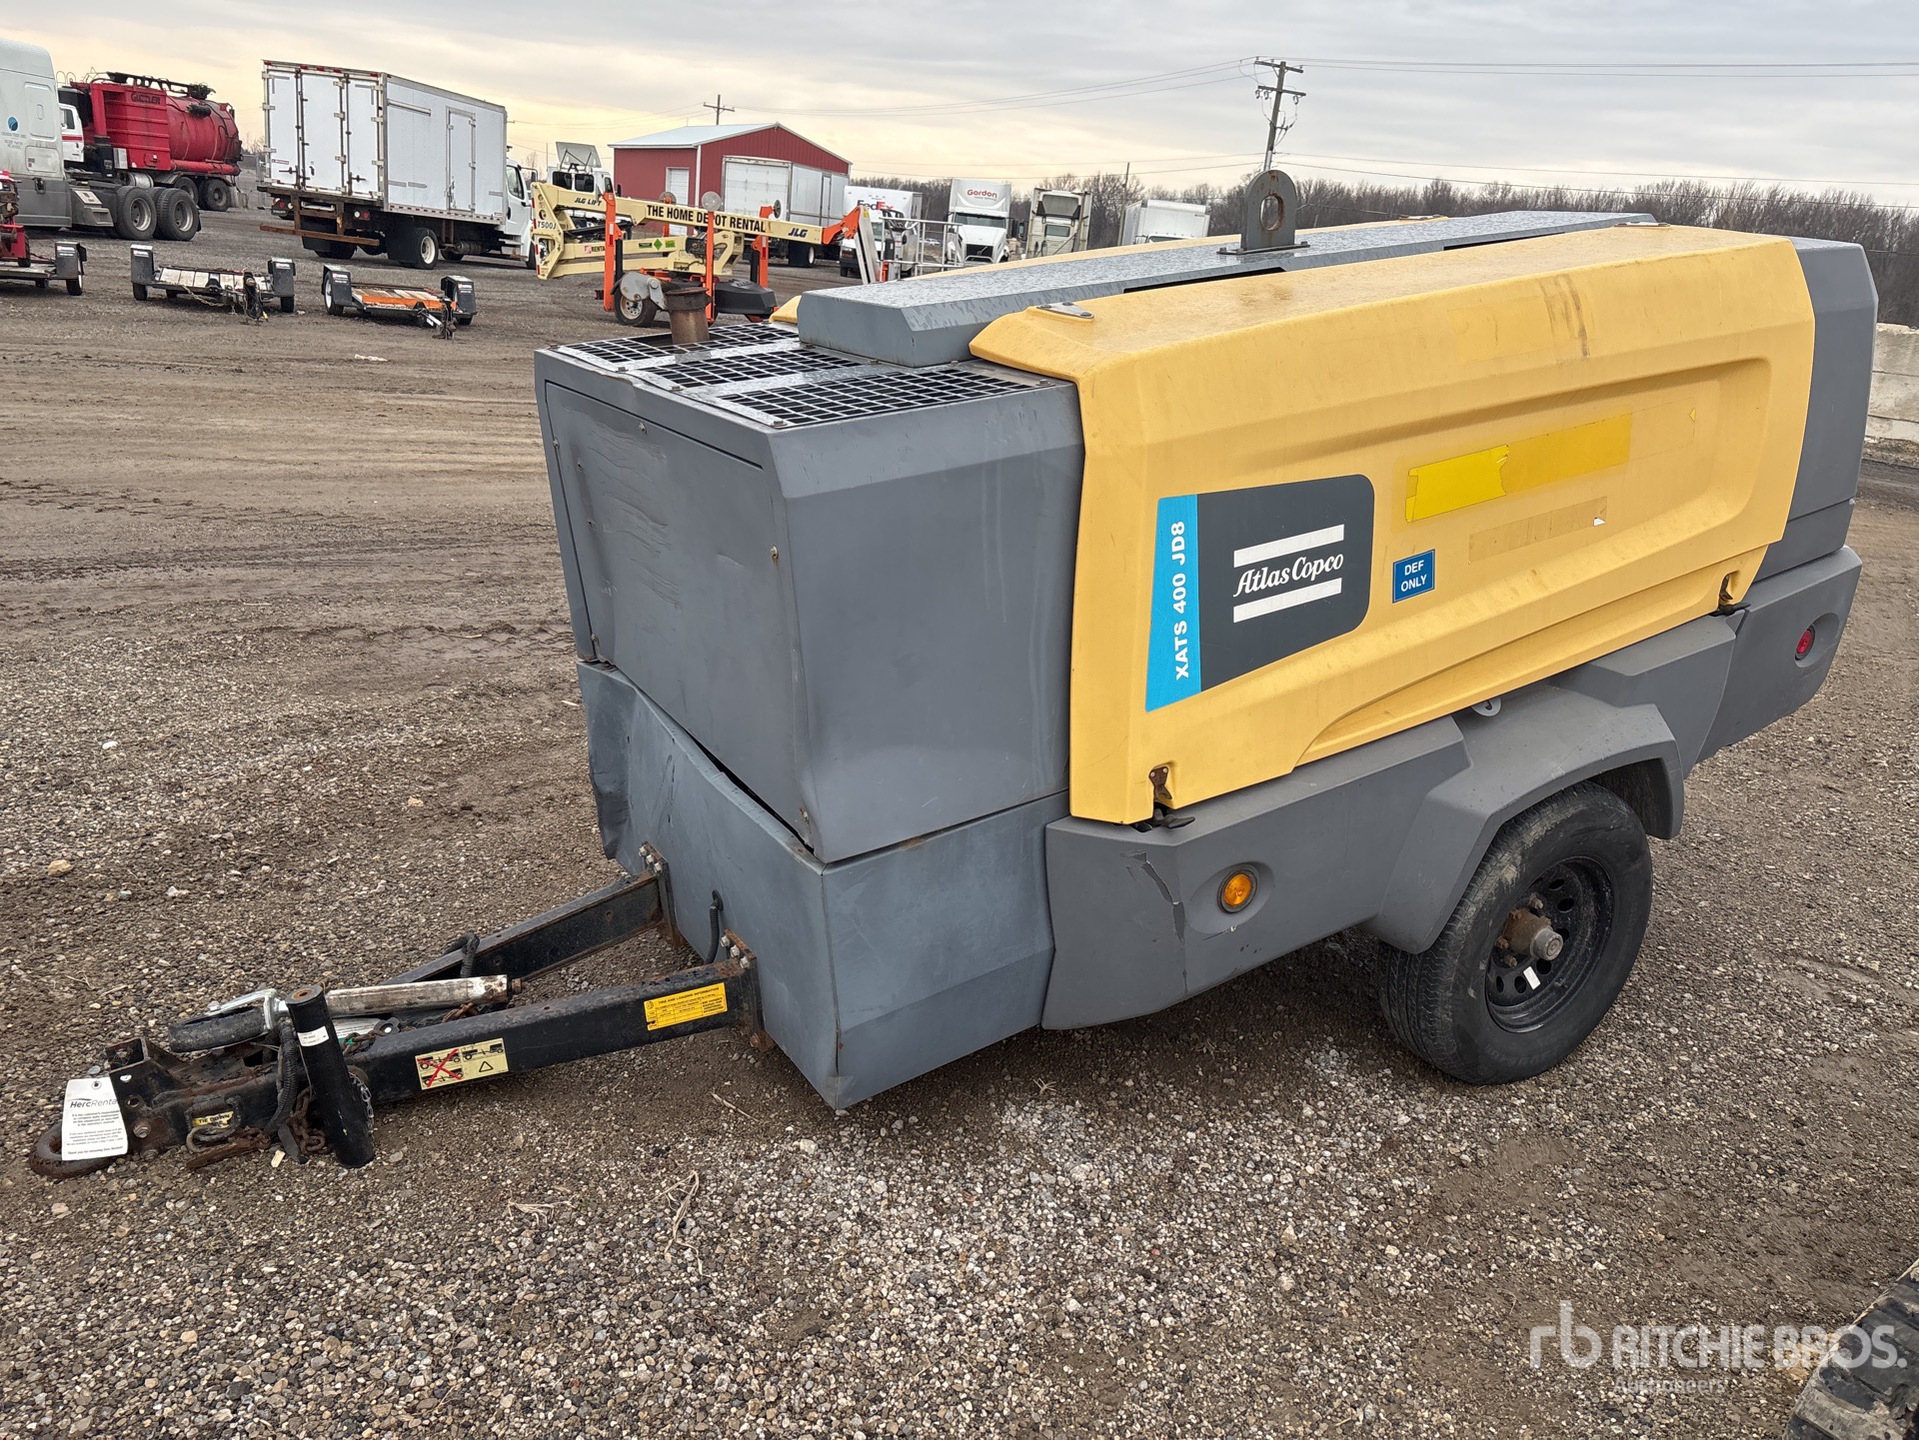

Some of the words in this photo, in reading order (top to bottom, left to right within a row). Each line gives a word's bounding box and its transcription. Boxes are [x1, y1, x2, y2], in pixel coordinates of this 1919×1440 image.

[575, 197, 586, 205] JLG
[966, 188, 998, 198] Gordon
[538, 220, 557, 230] T500J
[647, 204, 664, 217] THE
[667, 207, 694, 222] HOME
[696, 211, 728, 227] DEOT
[729, 216, 766, 233] RENTAL
[788, 227, 808, 238] JLG
[591, 245, 606, 253] RENTA
[1170, 520, 1186, 566] JD8
[1232, 566, 1290, 598] Atlas
[1291, 553, 1345, 582] Copco
[1403, 559, 1425, 577] DEF
[1400, 574, 1428, 593] ONLY
[1172, 573, 1187, 615] 400
[1173, 620, 1190, 682] XATS
[69, 1099, 118, 1109] HercRenta
